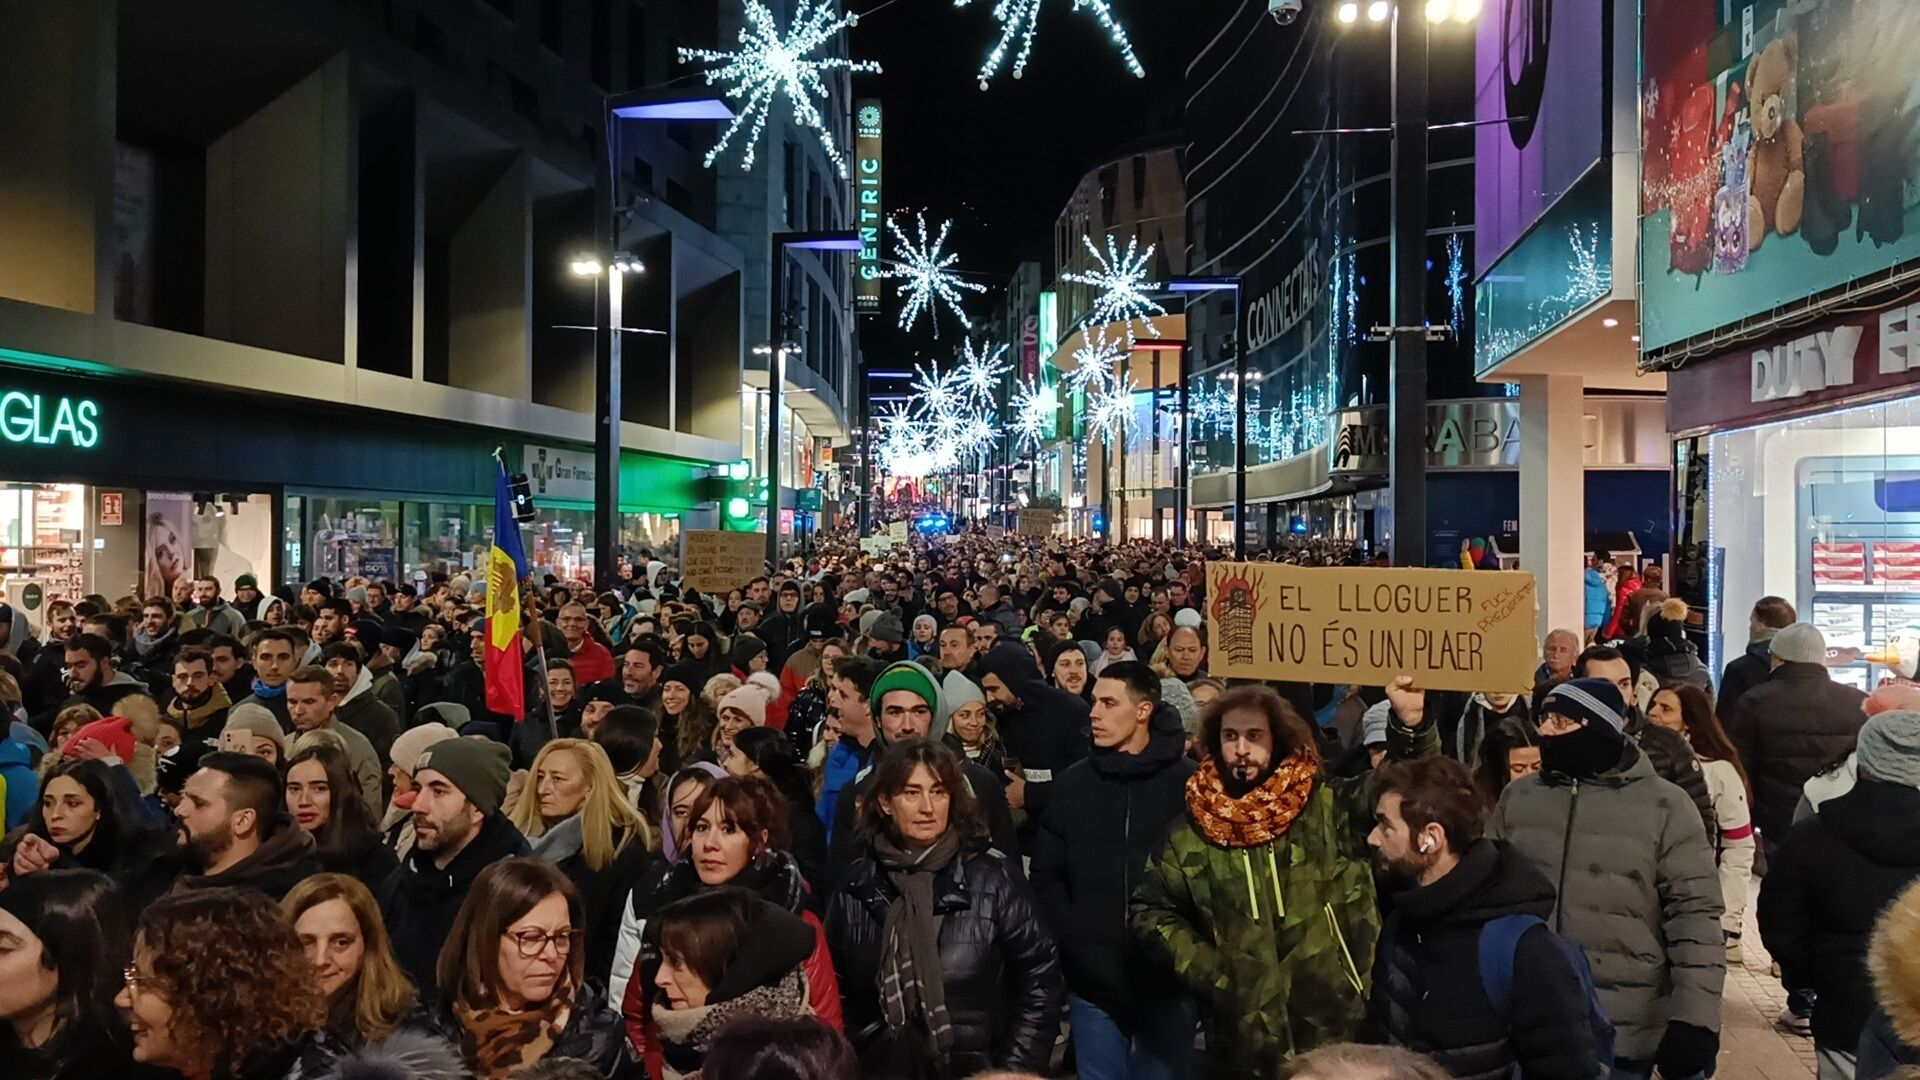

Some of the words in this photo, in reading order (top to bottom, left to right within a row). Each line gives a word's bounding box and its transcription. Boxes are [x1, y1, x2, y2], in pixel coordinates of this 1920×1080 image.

[1751, 324, 1863, 403] DUTY
[555, 457, 571, 479] Gran
[1280, 585, 1311, 611] EL
[1338, 584, 1472, 614] LLOGUER
[1481, 589, 1512, 611] FUCK
[1268, 622, 1306, 666] NO
[1322, 620, 1358, 668] ÉS
[1370, 629, 1404, 670] UN
[1414, 628, 1483, 672] PLAER
